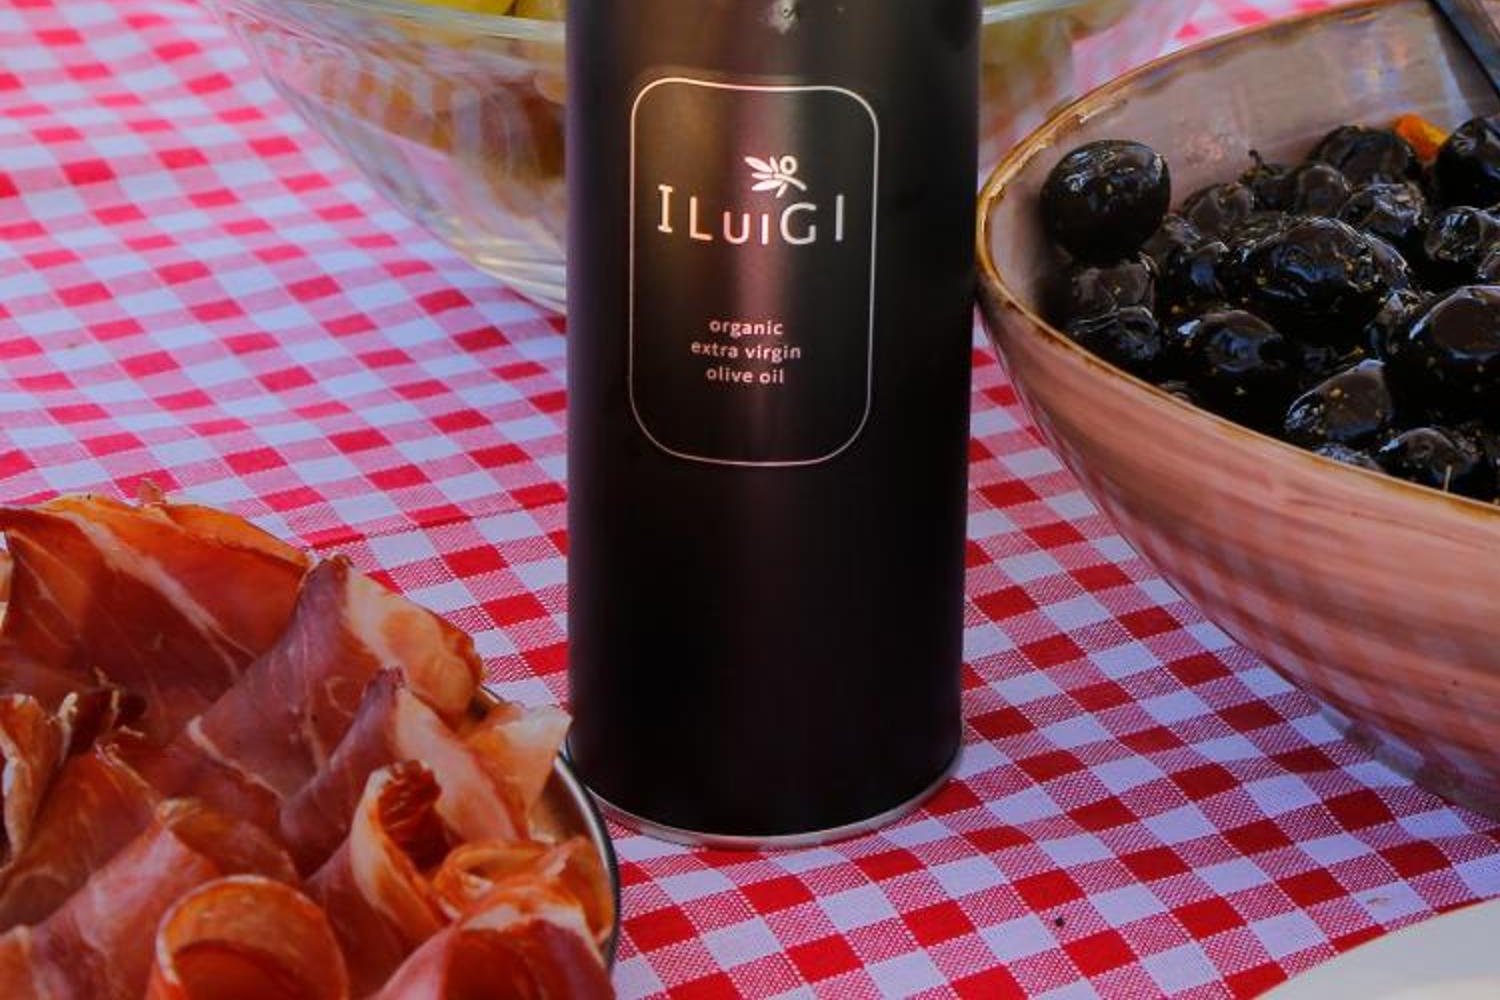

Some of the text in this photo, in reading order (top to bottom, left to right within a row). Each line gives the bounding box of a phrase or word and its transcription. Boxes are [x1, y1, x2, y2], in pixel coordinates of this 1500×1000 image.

[708, 319, 784, 338] organic
[690, 340, 802, 363] extra virgin
[705, 365, 785, 385] olive oil
